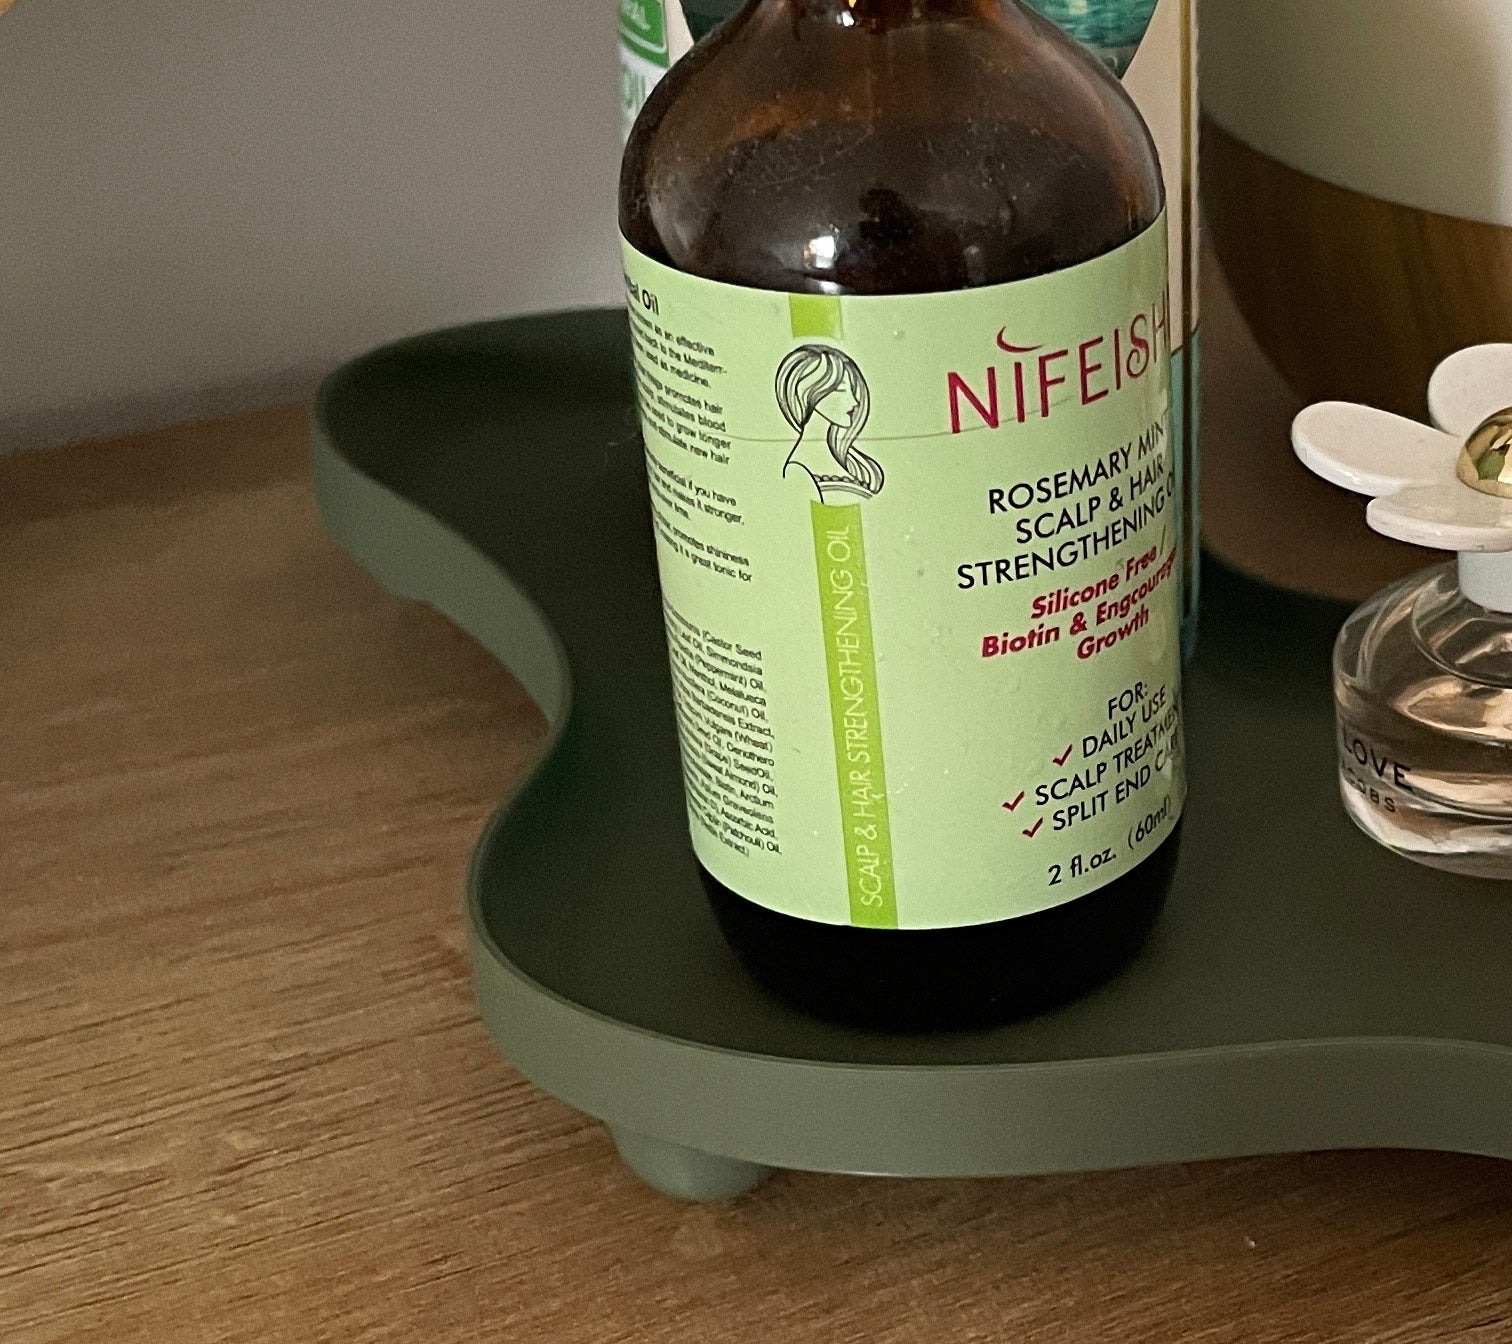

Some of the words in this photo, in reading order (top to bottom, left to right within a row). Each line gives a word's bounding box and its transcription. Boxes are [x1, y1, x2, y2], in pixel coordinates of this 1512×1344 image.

[697, 414, 726, 433] blood
[698, 431, 731, 450] longer
[709, 450, 729, 465] hair
[988, 442, 1132, 514] ROSEMARY
[694, 486, 710, 498] you
[712, 490, 736, 506] have
[1016, 495, 1101, 544] SCALP
[1108, 485, 1124, 512] &
[1130, 452, 1164, 501] HAIR
[826, 525, 851, 563] OIL
[957, 486, 1165, 589] STRENGTHENING
[1031, 573, 1120, 619] Silicone
[1126, 545, 1157, 582] Free
[735, 644, 762, 660] Seed
[982, 623, 1060, 657] Biotin
[1070, 611, 1088, 635] &
[1077, 604, 1149, 659] Growth
[829, 568, 871, 764] STRENGTHENING
[1083, 711, 1136, 758] DAILY
[1142, 684, 1166, 723] USE
[1108, 681, 1148, 720] FOR:
[850, 769, 876, 818] HAIR
[1035, 762, 1107, 806] SCALP
[1053, 790, 1109, 831] SPLIT
[1115, 764, 1150, 804] END
[854, 824, 878, 841] &
[856, 844, 884, 907] SCALP
[1048, 864, 1062, 886] 2
